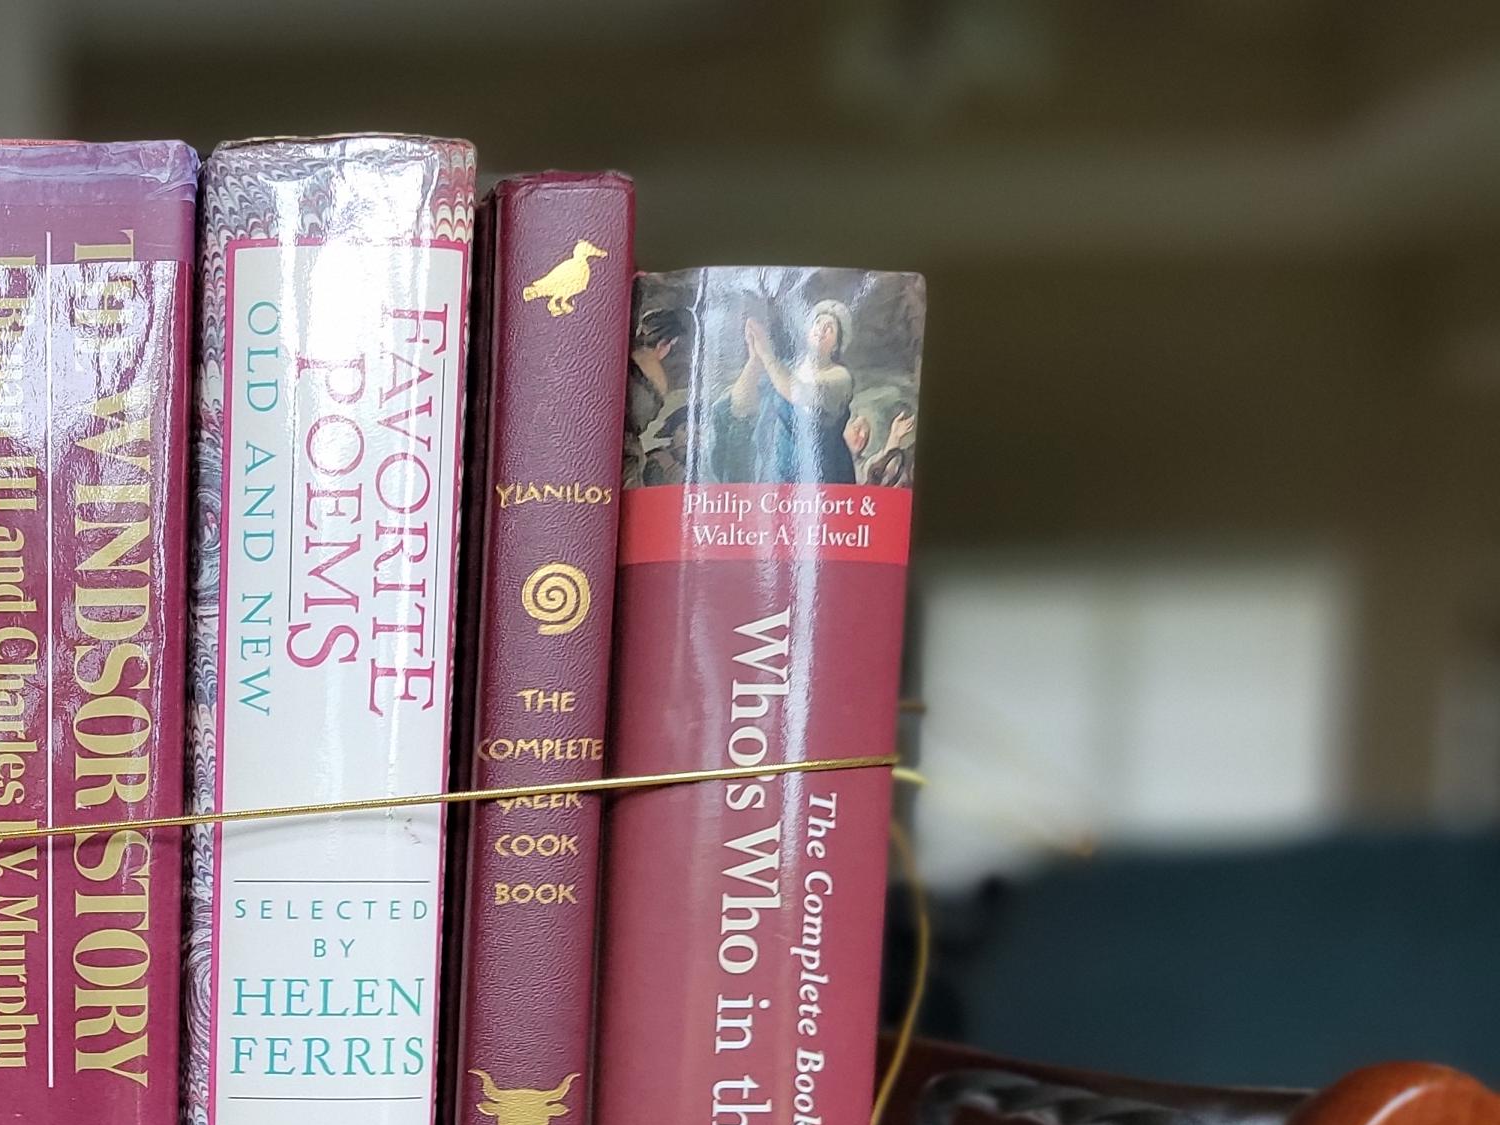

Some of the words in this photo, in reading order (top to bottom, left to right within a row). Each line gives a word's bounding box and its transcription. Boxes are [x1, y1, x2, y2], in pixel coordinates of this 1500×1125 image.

[246, 301, 280, 414] OLD
[243, 441, 277, 564] AND
[287, 356, 367, 673] POEMS
[368, 302, 449, 718] FAVORITE
[686, 491, 751, 521] Philip
[760, 491, 854, 516] Comfort
[860, 496, 876, 516] &
[692, 523, 768, 547] Walter
[773, 526, 797, 547] A.
[806, 525, 870, 548] Elwell
[72, 390, 153, 811] WINDSOR
[238, 592, 274, 717] NEW
[516, 687, 577, 713] THE
[477, 737, 605, 764] COMPLETE
[494, 834, 580, 858] COOK
[806, 792, 838, 860] The
[234, 898, 428, 921] SELECTED
[494, 882, 579, 906] BOOK
[716, 820, 782, 975] Who
[73, 828, 151, 1089] STORY
[313, 937, 357, 959] BY
[790, 868, 834, 1036] Complete
[232, 977, 424, 1018] HELEN
[714, 994, 772, 1055] in
[230, 1035, 425, 1077] FERRIS
